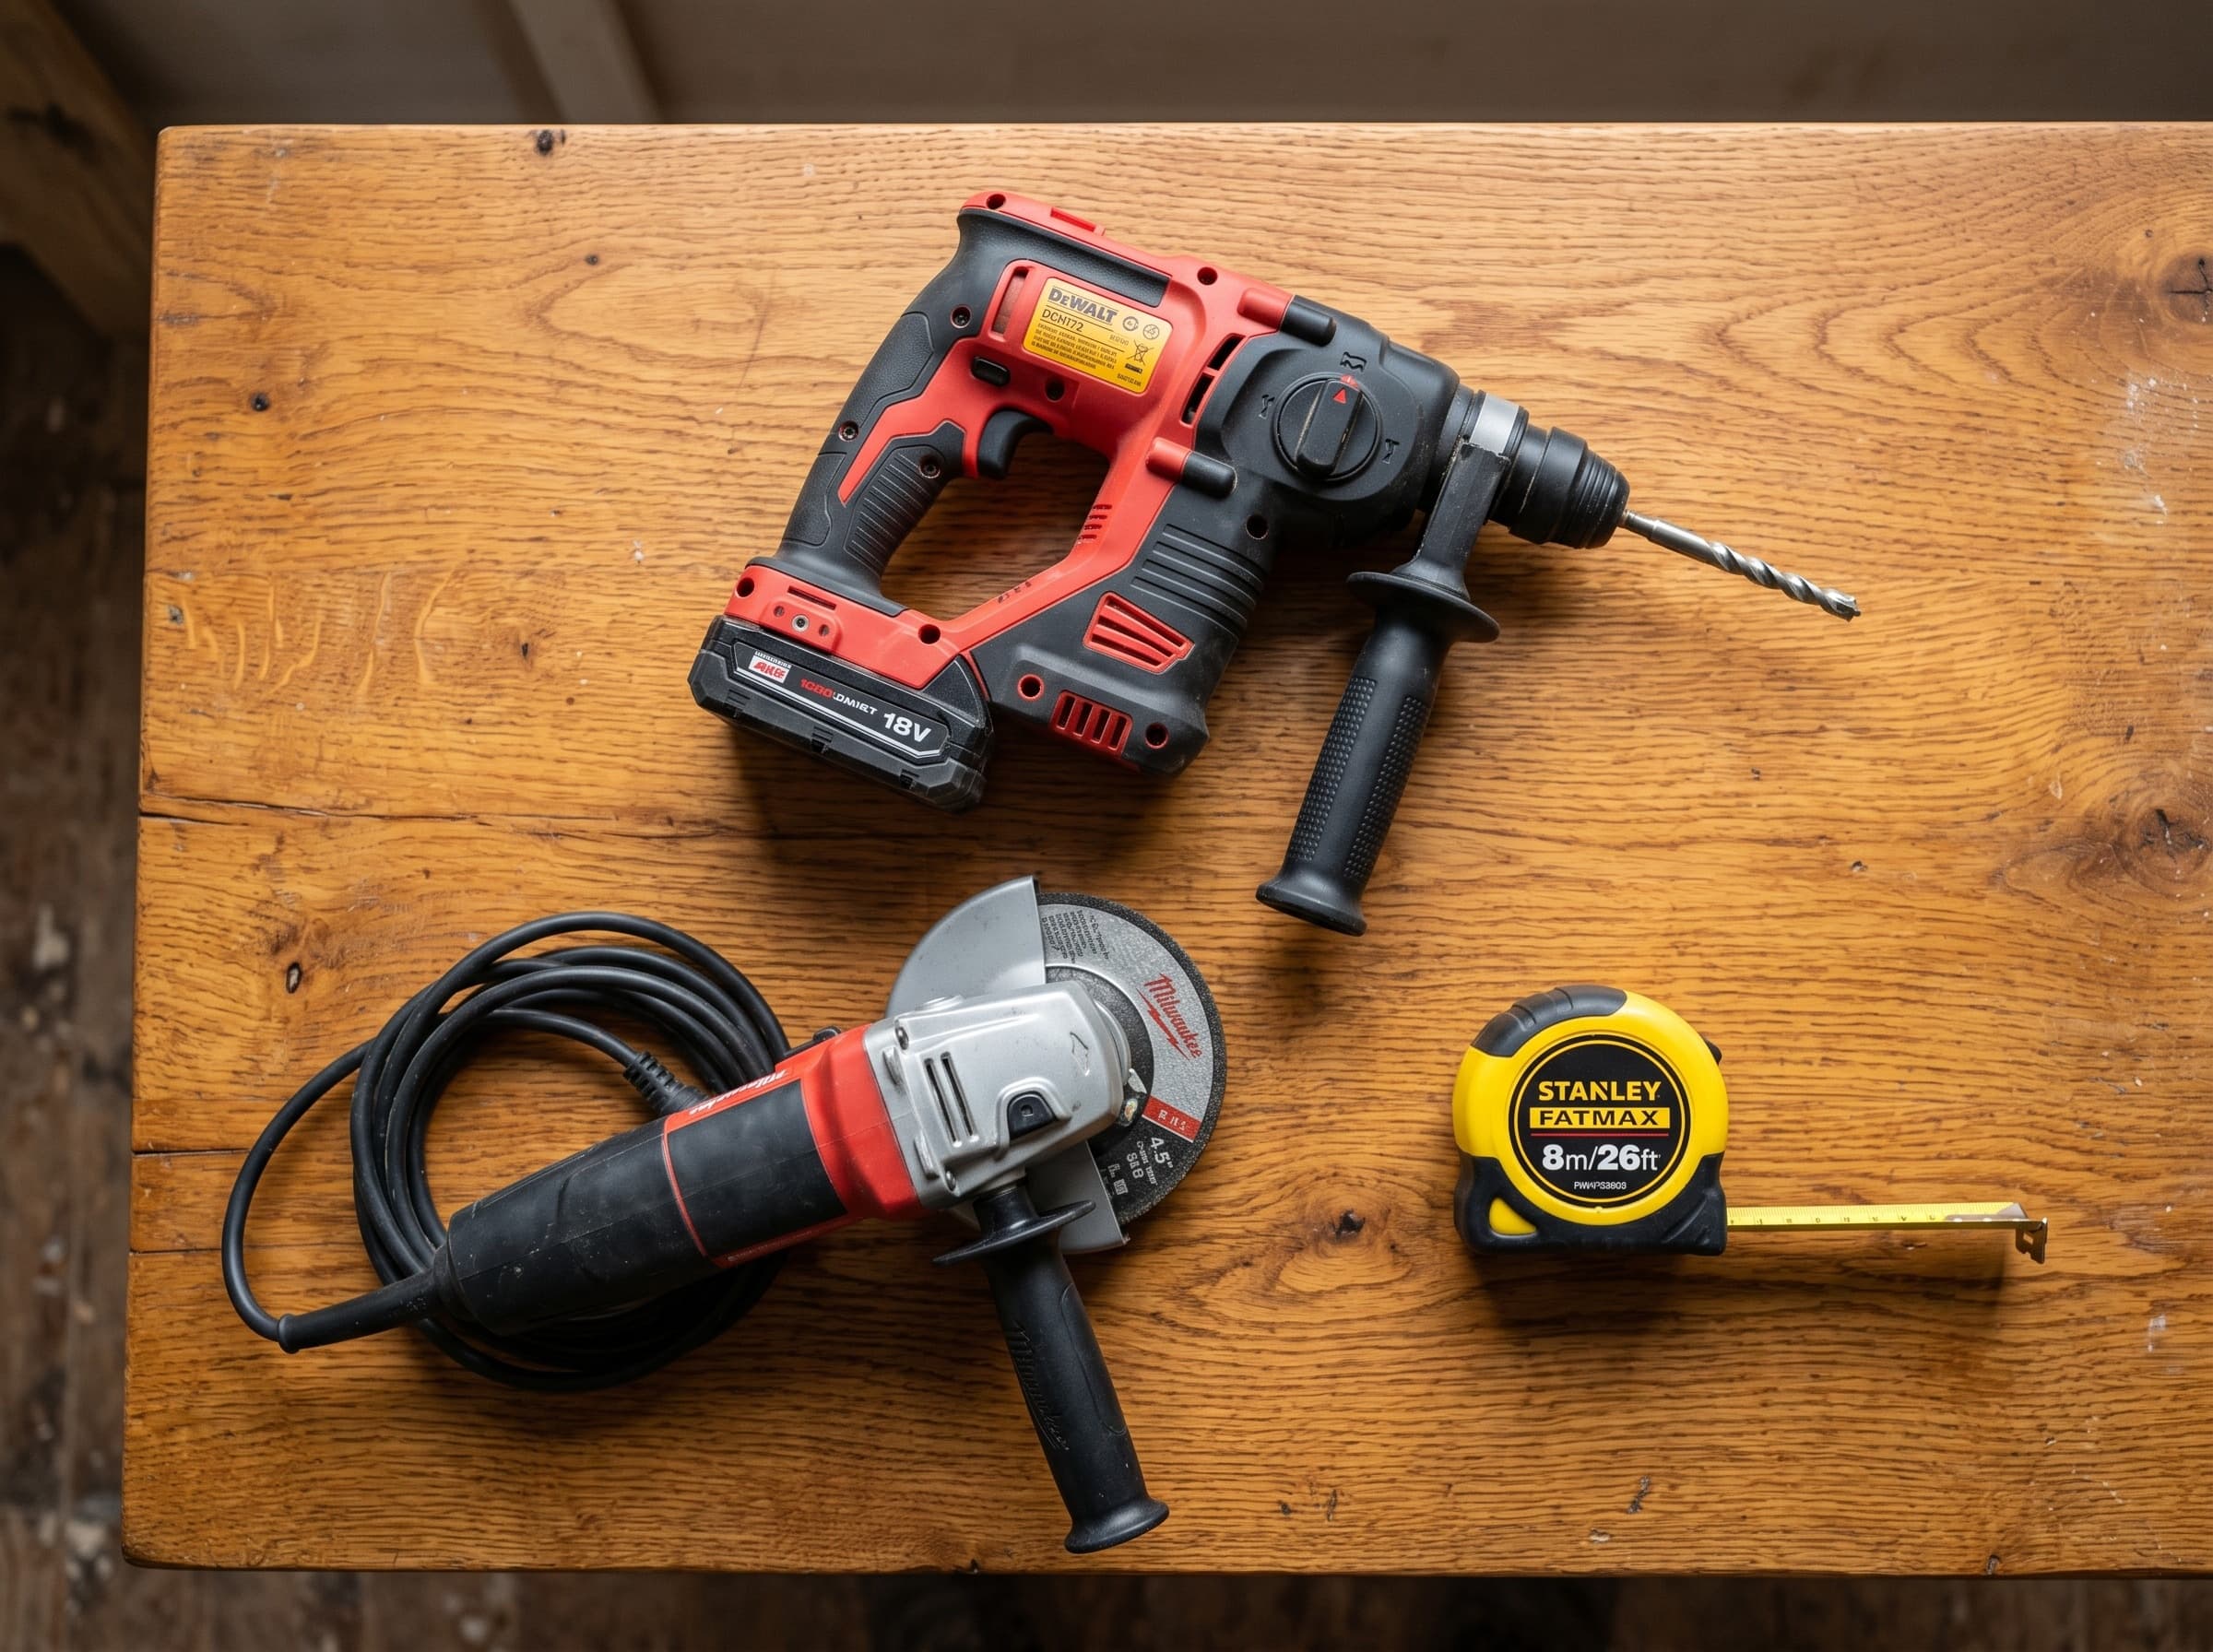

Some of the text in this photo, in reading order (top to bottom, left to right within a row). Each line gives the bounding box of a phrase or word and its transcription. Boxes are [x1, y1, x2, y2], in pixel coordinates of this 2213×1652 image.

[883, 713, 931, 742] 18V
[1144, 973, 1202, 1058] Milwaukee
[1538, 1081, 1661, 1101] STANLEY
[1540, 1110, 1658, 1126] FATMAX
